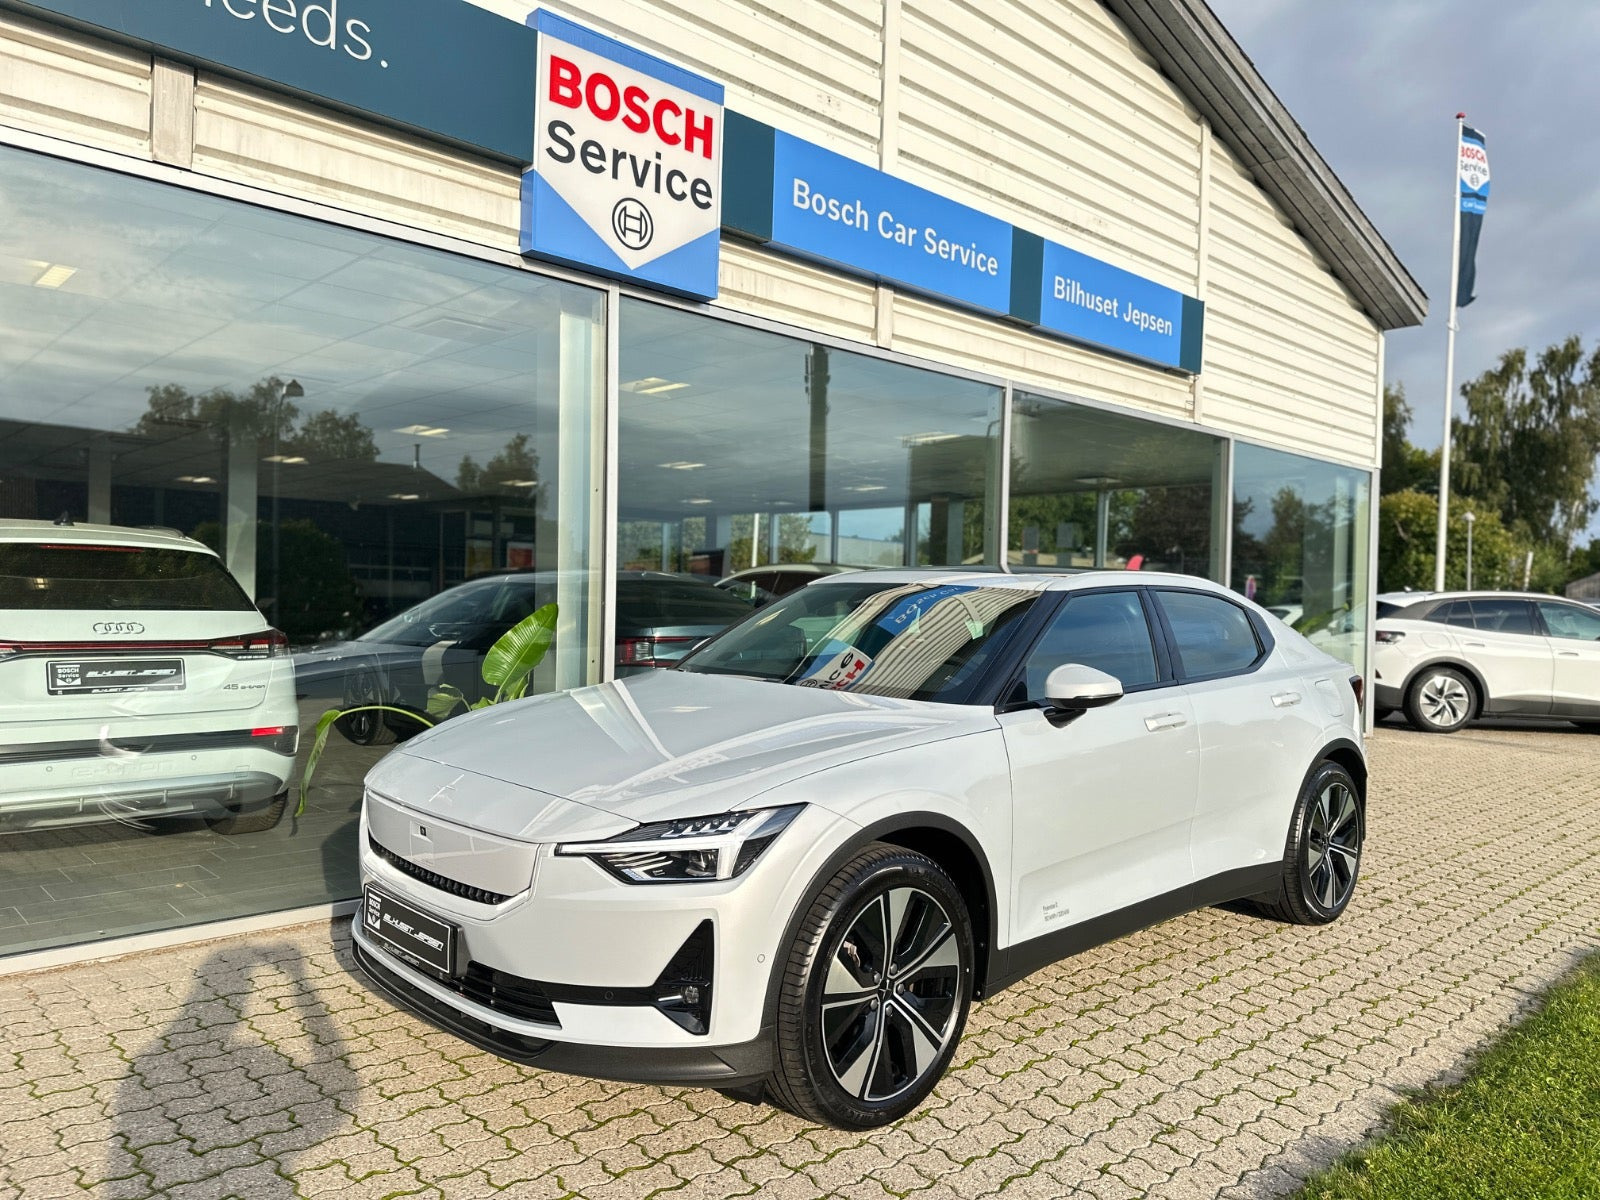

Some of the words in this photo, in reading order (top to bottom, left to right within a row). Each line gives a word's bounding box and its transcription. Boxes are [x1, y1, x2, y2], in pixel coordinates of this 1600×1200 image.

[205, 0, 388, 69] eeds.
[549, 54, 713, 160] BOSCH
[545, 120, 713, 210] Service
[792, 177, 869, 231] Bosch
[877, 210, 918, 247] Car
[923, 227, 999, 276] Service
[1053, 275, 1119, 319] Bilhuset
[1122, 301, 1173, 337] Jepsen
